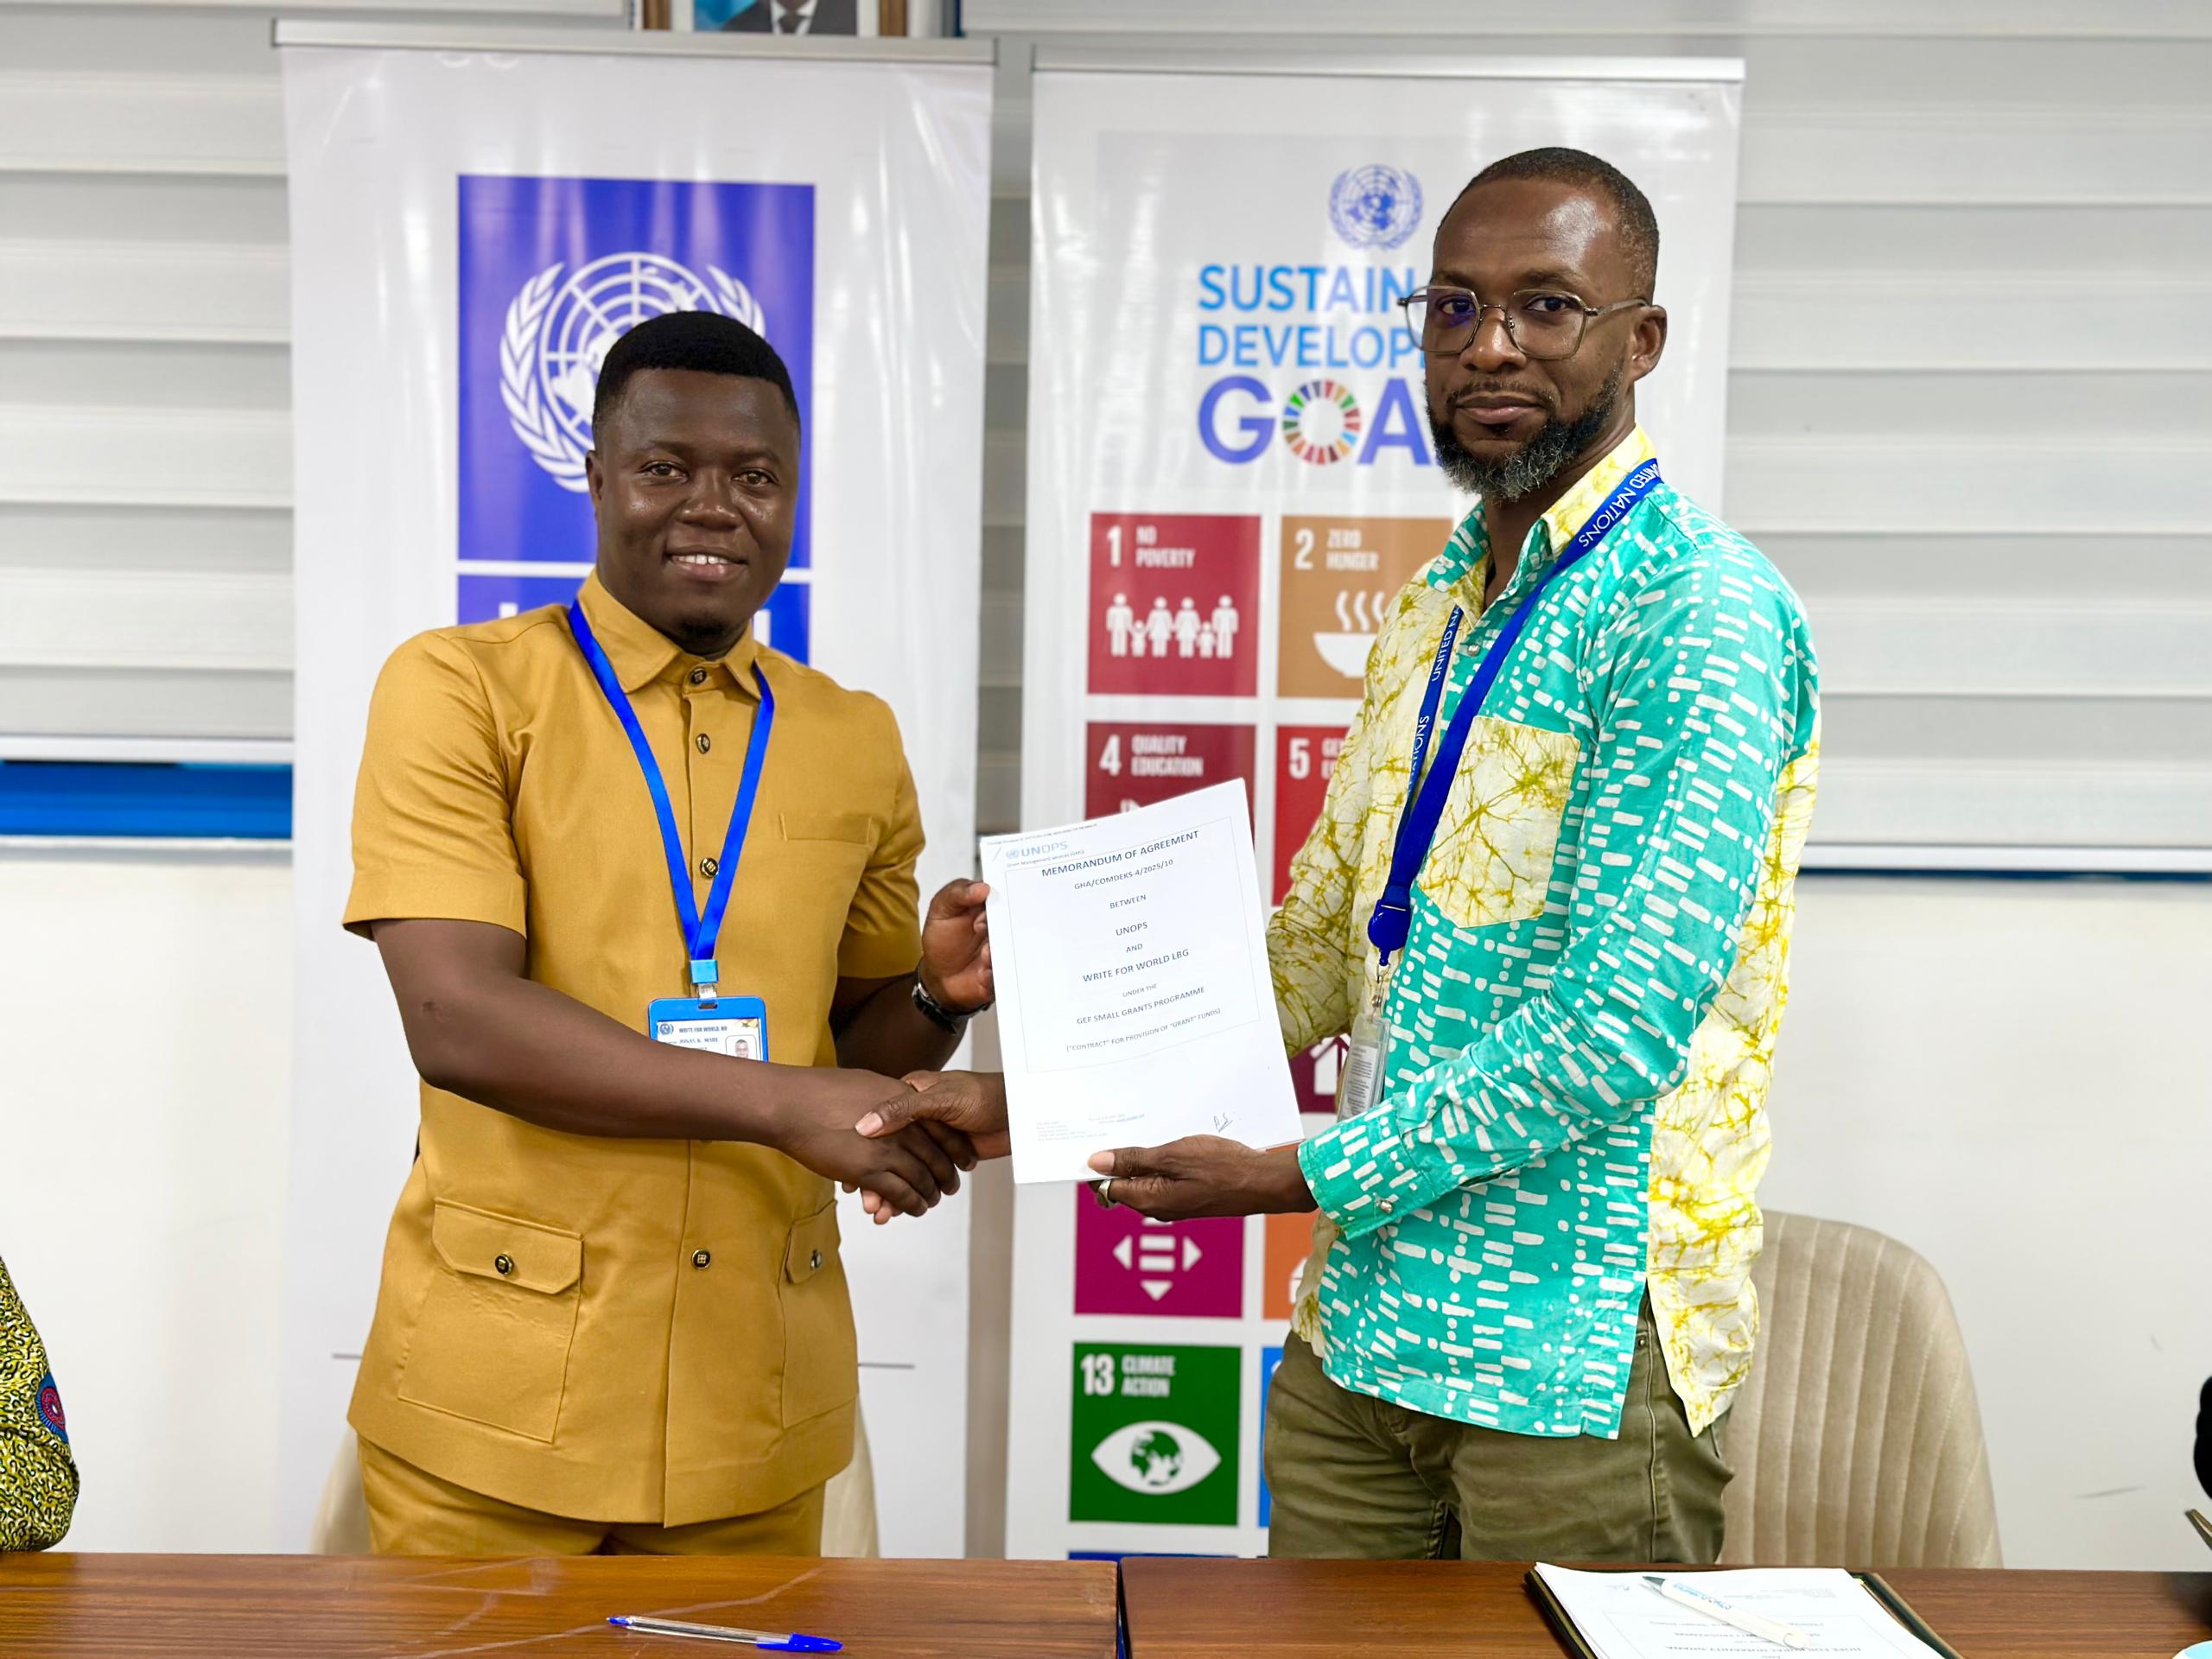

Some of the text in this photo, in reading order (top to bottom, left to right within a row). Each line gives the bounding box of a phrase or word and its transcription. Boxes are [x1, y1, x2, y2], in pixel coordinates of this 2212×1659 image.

[1198, 264, 1414, 313] SUSTAIN
[1198, 325, 1421, 369] DEVELOP
[1198, 374, 1434, 467] GOA
[1578, 486, 1637, 548] NATIONS
[1107, 524, 1122, 568] 1
[1135, 524, 1158, 546] NO
[1327, 528, 1362, 549] ZERO
[1135, 547, 1196, 569] POVERTY
[1294, 528, 1314, 570] 2
[1326, 550, 1379, 571] HUNGER
[1431, 630, 1453, 683] UNITED
[1099, 734, 1122, 776] 4
[1131, 734, 1187, 754] QUALITY
[1130, 756, 1204, 777] EDUCATION
[1288, 737, 1311, 780] 5
[1020, 841, 1068, 857] UNOPS
[1041, 830, 1199, 877] MEMORANDUM OF AGREEMENT
[1074, 859, 1173, 889] GHA/COMDEKS-4/2025/10
[1109, 894, 1147, 909] BETWEEN
[1116, 921, 1148, 936] UNOPS
[1126, 944, 1143, 953] AND
[1083, 949, 1189, 982] WRITE FOR WORLD LBG
[1077, 986, 1205, 1025] GEF SMALL GRANTS PROGRAMME
[1122, 988, 1145, 997] UNDER
[1125, 1028, 1160, 1041] PROVISION
[1080, 1353, 1115, 1396] 13
[1122, 1354, 1176, 1377] CLIMATE
[1122, 1376, 1171, 1397] ACTION
